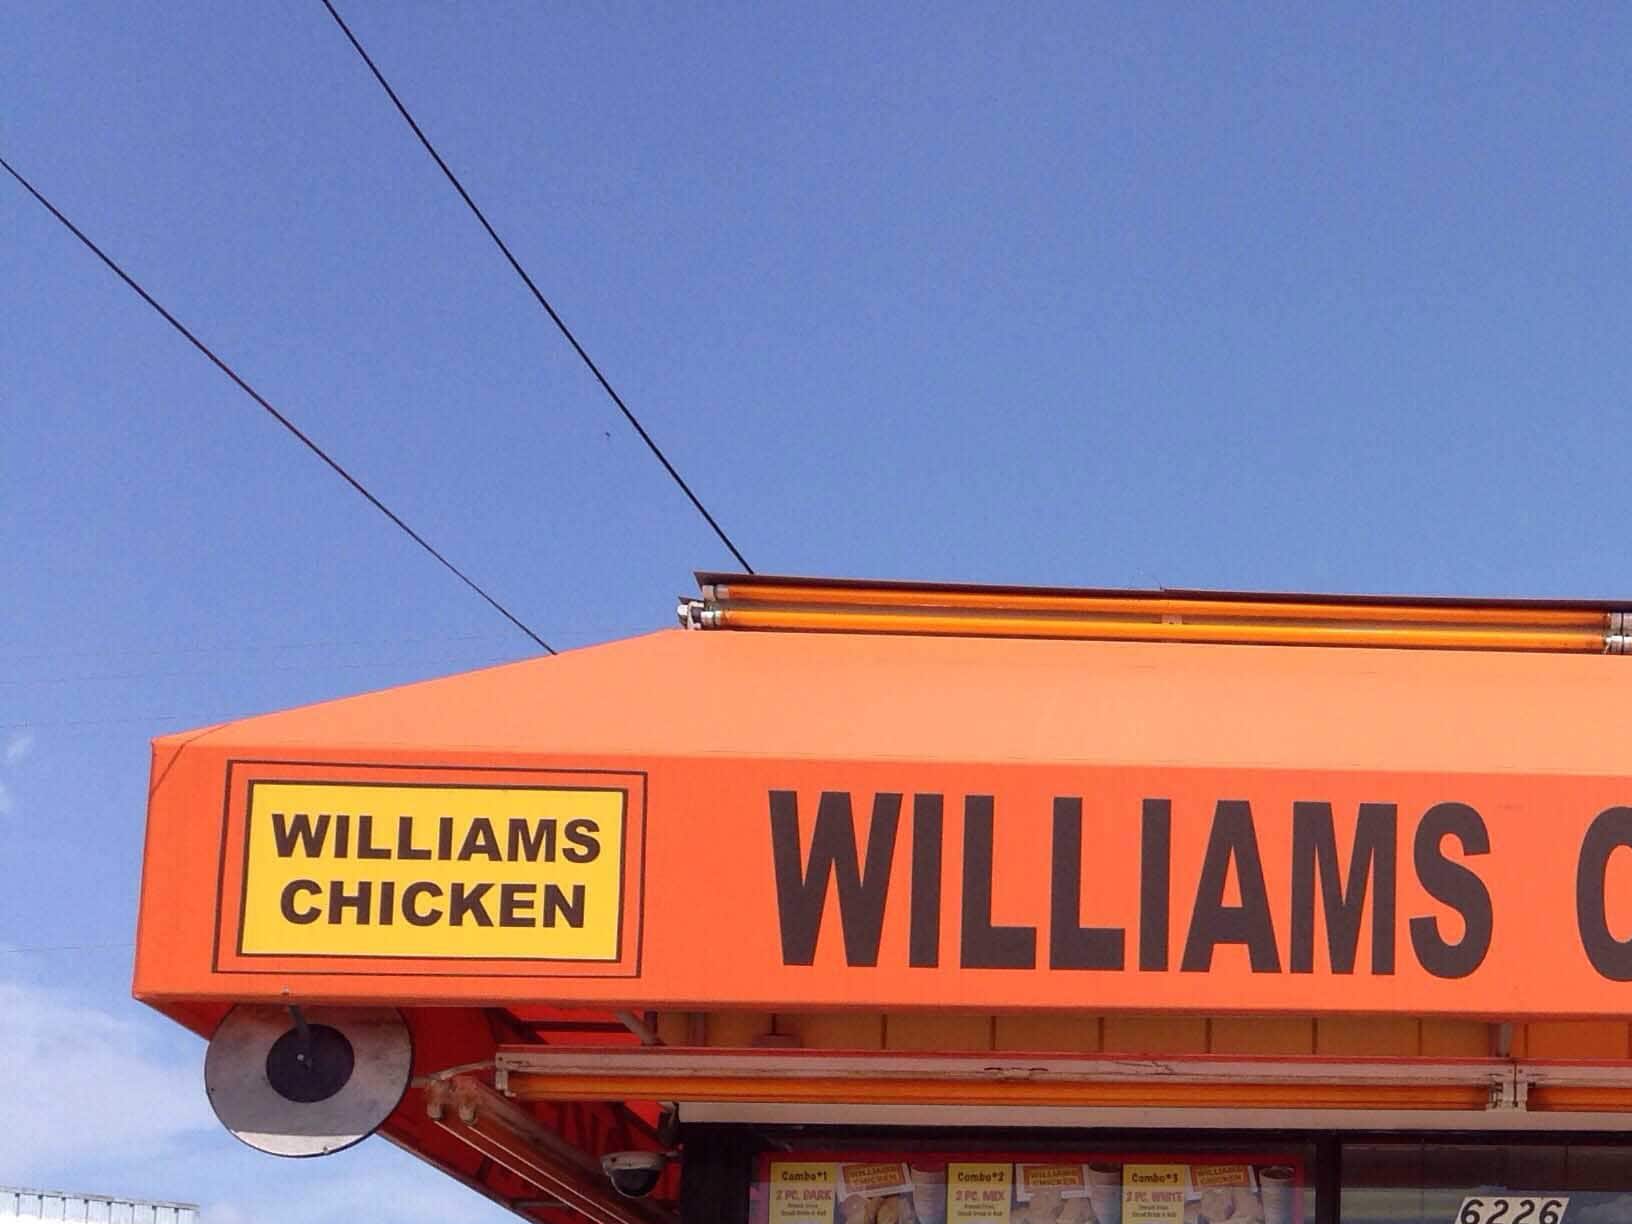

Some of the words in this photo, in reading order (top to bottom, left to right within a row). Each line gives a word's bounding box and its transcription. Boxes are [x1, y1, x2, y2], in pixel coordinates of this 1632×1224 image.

[272, 813, 601, 864] WILLIAMS
[280, 879, 585, 929] CHICKEN
[769, 790, 1494, 980] WILLIAMS
